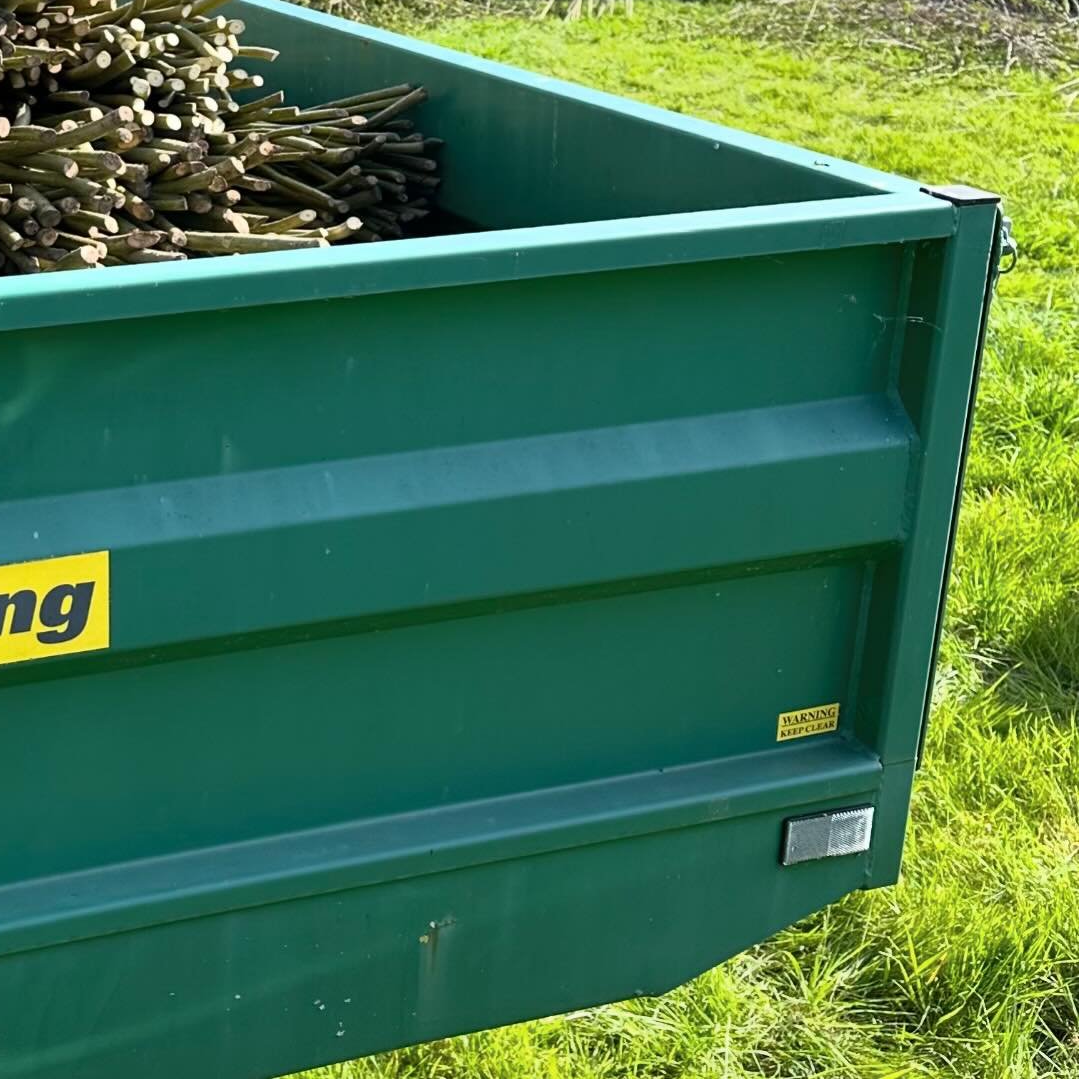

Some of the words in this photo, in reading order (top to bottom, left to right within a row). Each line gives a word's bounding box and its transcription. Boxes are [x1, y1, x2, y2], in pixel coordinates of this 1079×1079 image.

[782, 706, 836, 726] WARNING
[780, 726, 805, 738] KEEP
[805, 720, 835, 733] CLEAR
